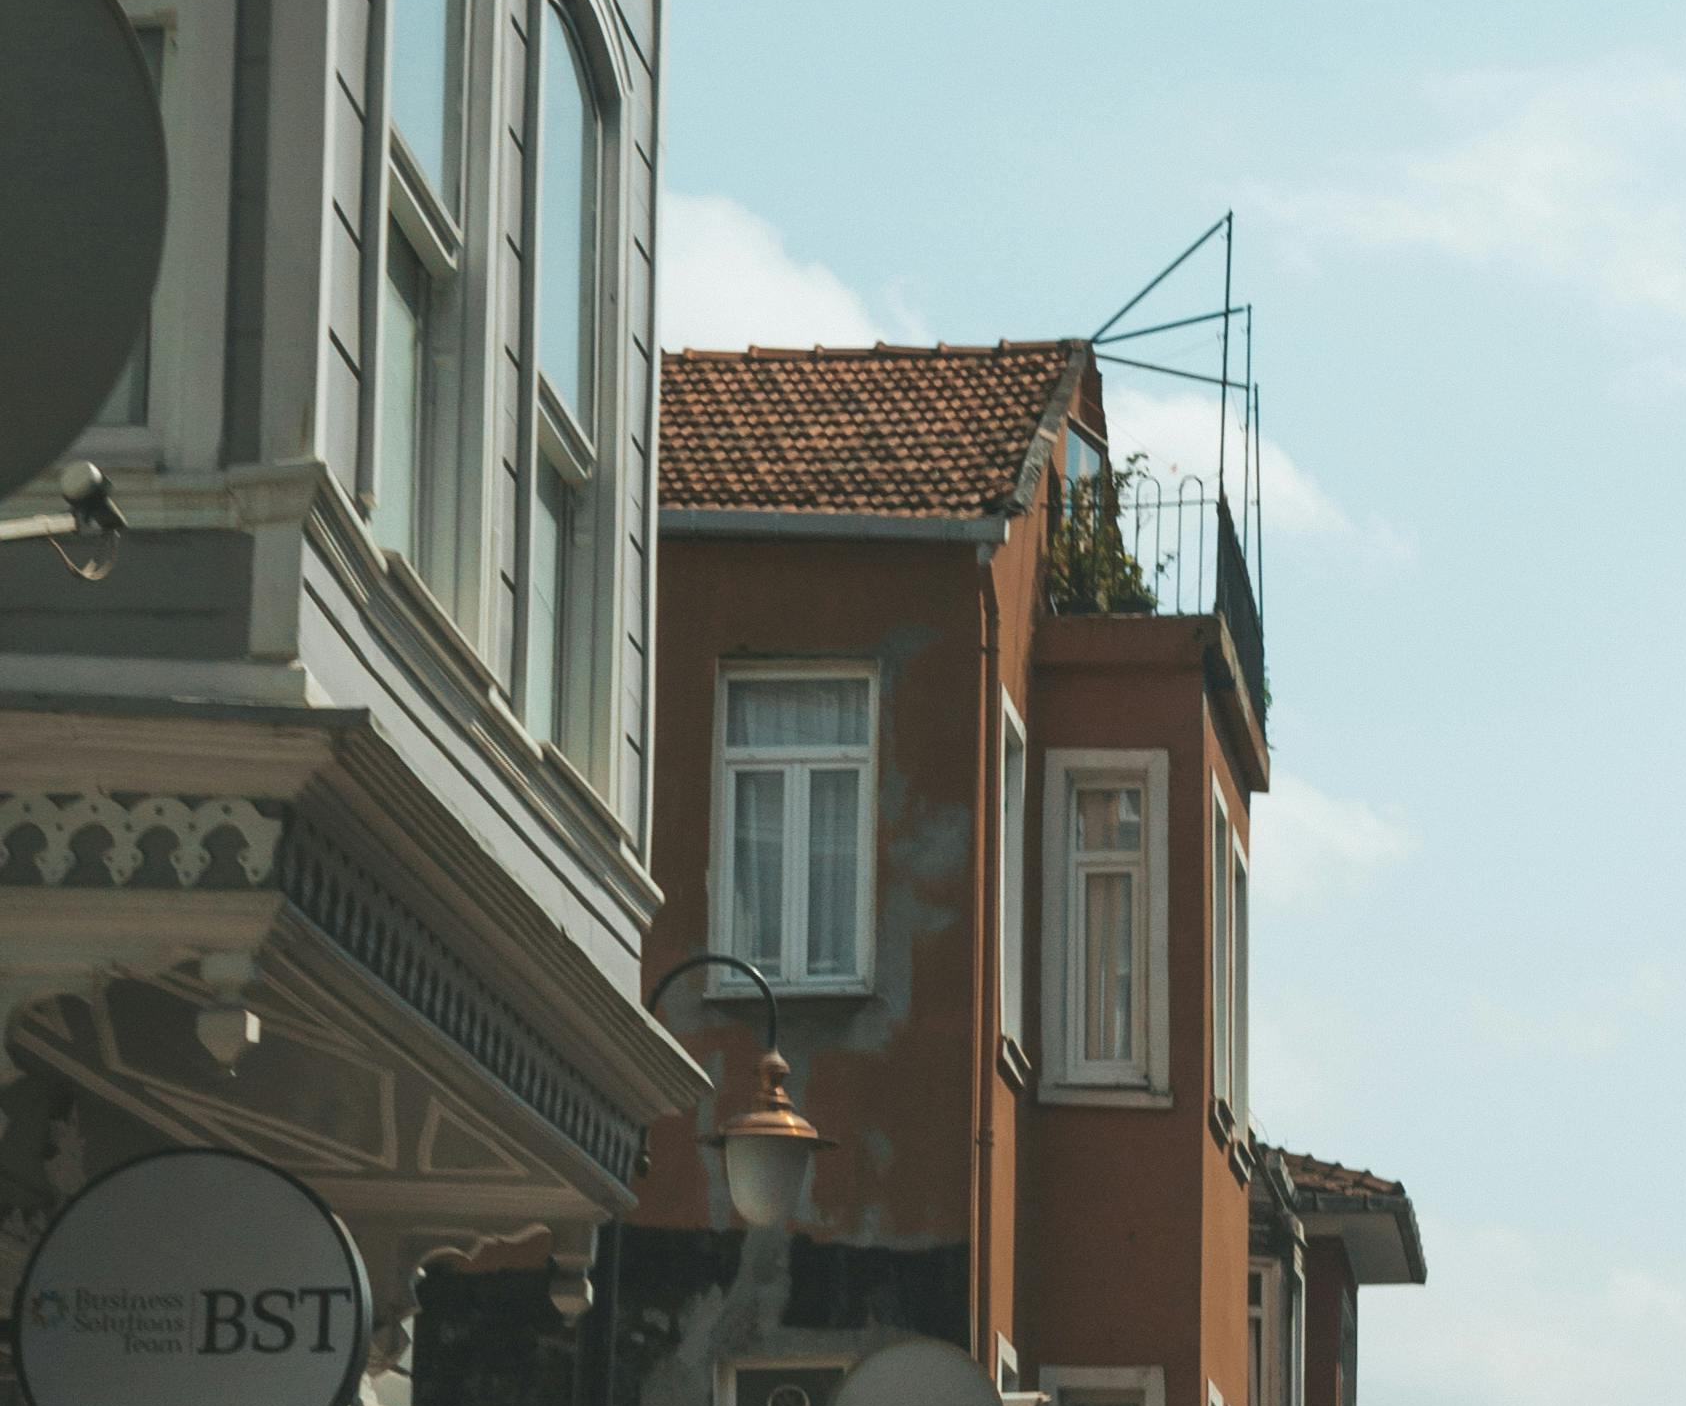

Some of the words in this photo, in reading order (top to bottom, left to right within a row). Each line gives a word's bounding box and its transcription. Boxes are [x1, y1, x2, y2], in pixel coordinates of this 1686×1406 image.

[75, 1289, 183, 1311] Business
[74, 1314, 183, 1333] Solutions
[198, 1288, 352, 1355] BST
[122, 1335, 183, 1353] Team
